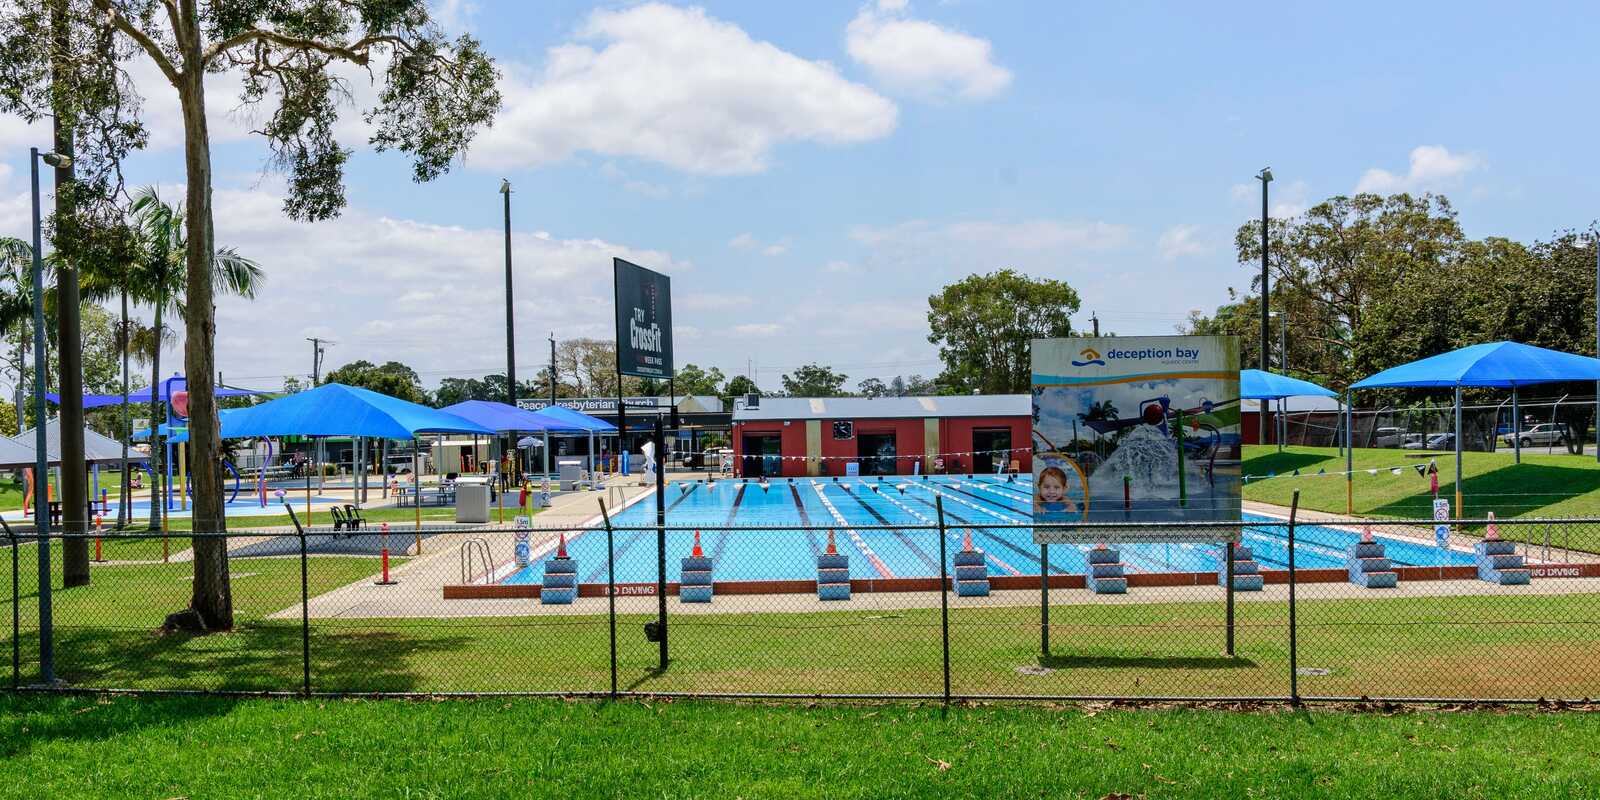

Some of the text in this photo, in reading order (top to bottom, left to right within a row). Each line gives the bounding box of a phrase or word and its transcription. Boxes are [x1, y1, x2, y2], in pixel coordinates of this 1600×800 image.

[634, 307, 645, 323] TRY
[630, 317, 662, 353] CrossFit
[1107, 347, 1200, 360] deception bay
[516, 400, 547, 411] Peace
[618, 398, 654, 409] hurch
[1531, 568, 1580, 577] NO DIVING
[621, 586, 655, 595] DIVING
